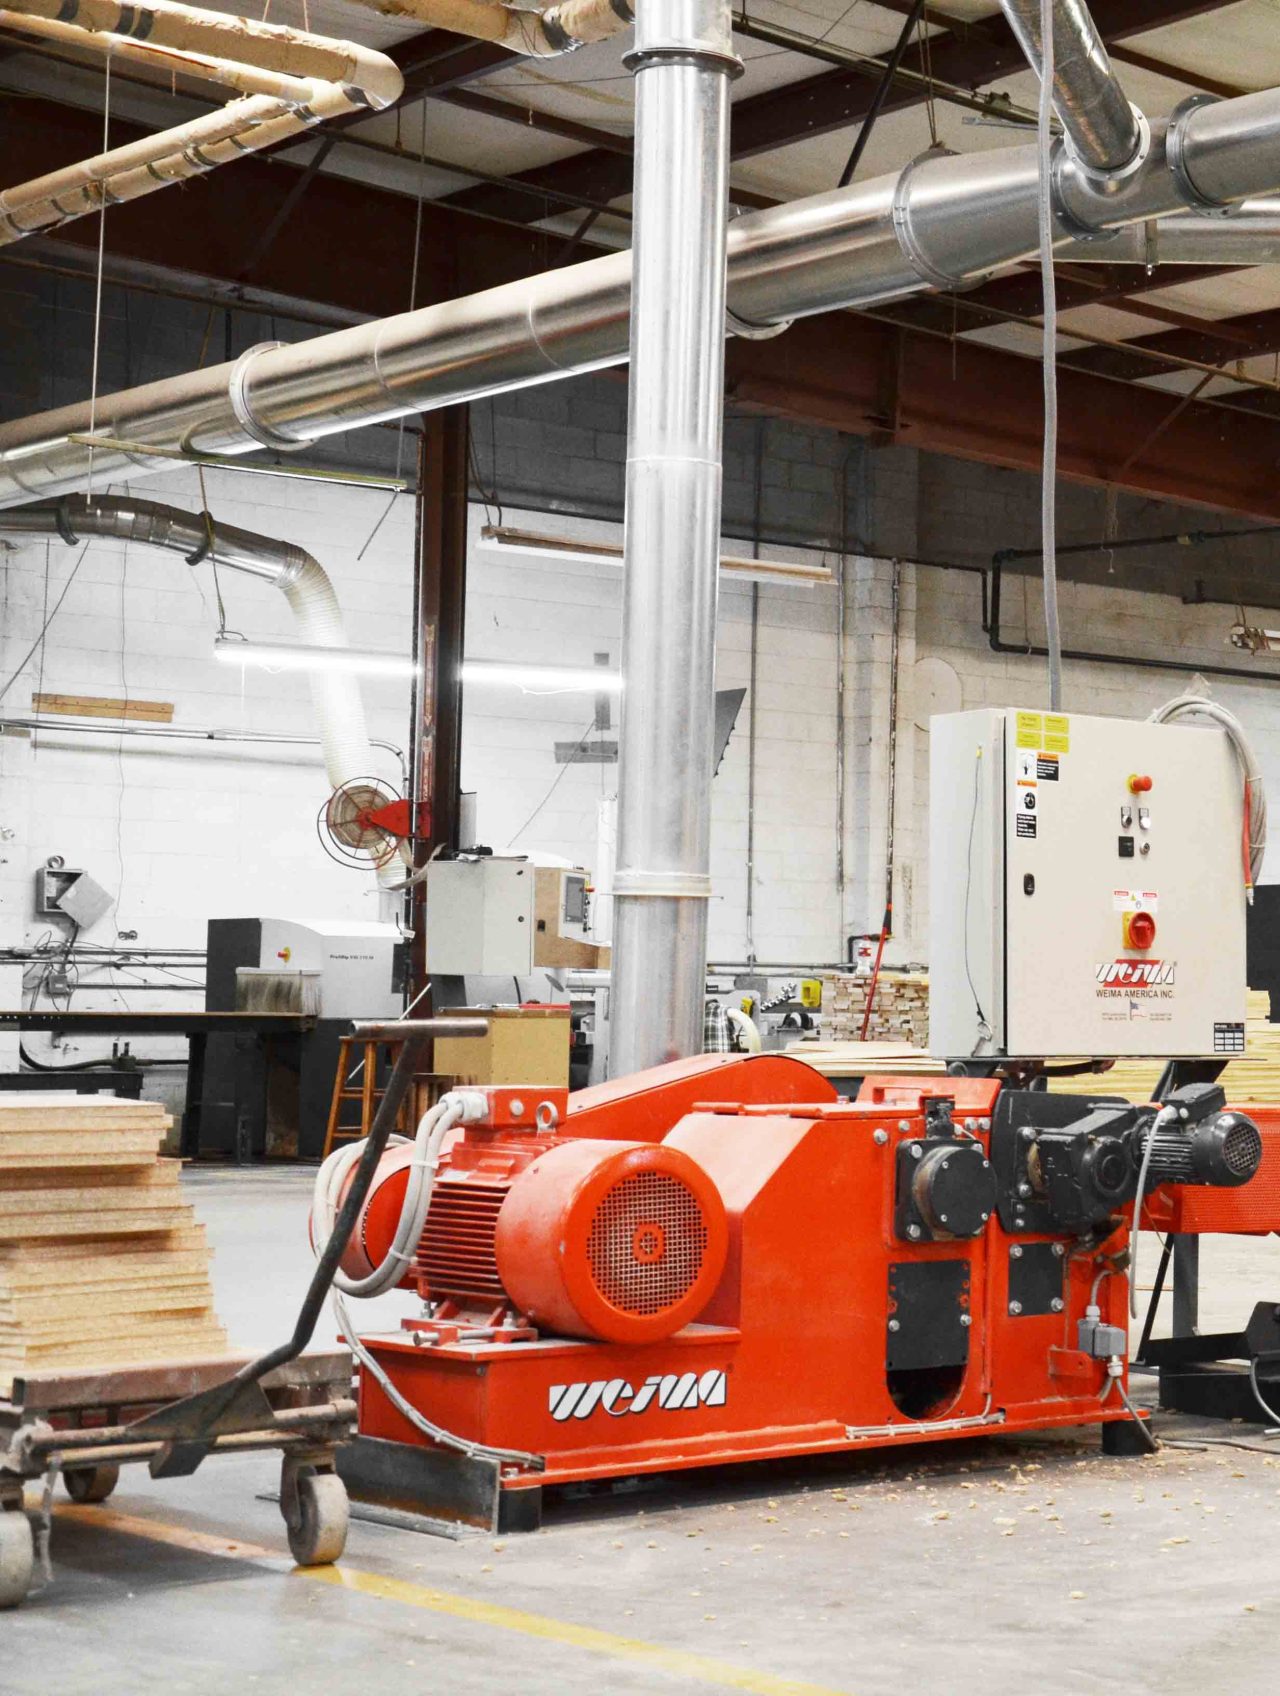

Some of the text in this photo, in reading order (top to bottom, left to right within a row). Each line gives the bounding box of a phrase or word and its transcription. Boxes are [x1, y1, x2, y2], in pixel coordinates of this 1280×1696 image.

[1096, 989, 1175, 999] WEIMA AMERICA INC.
